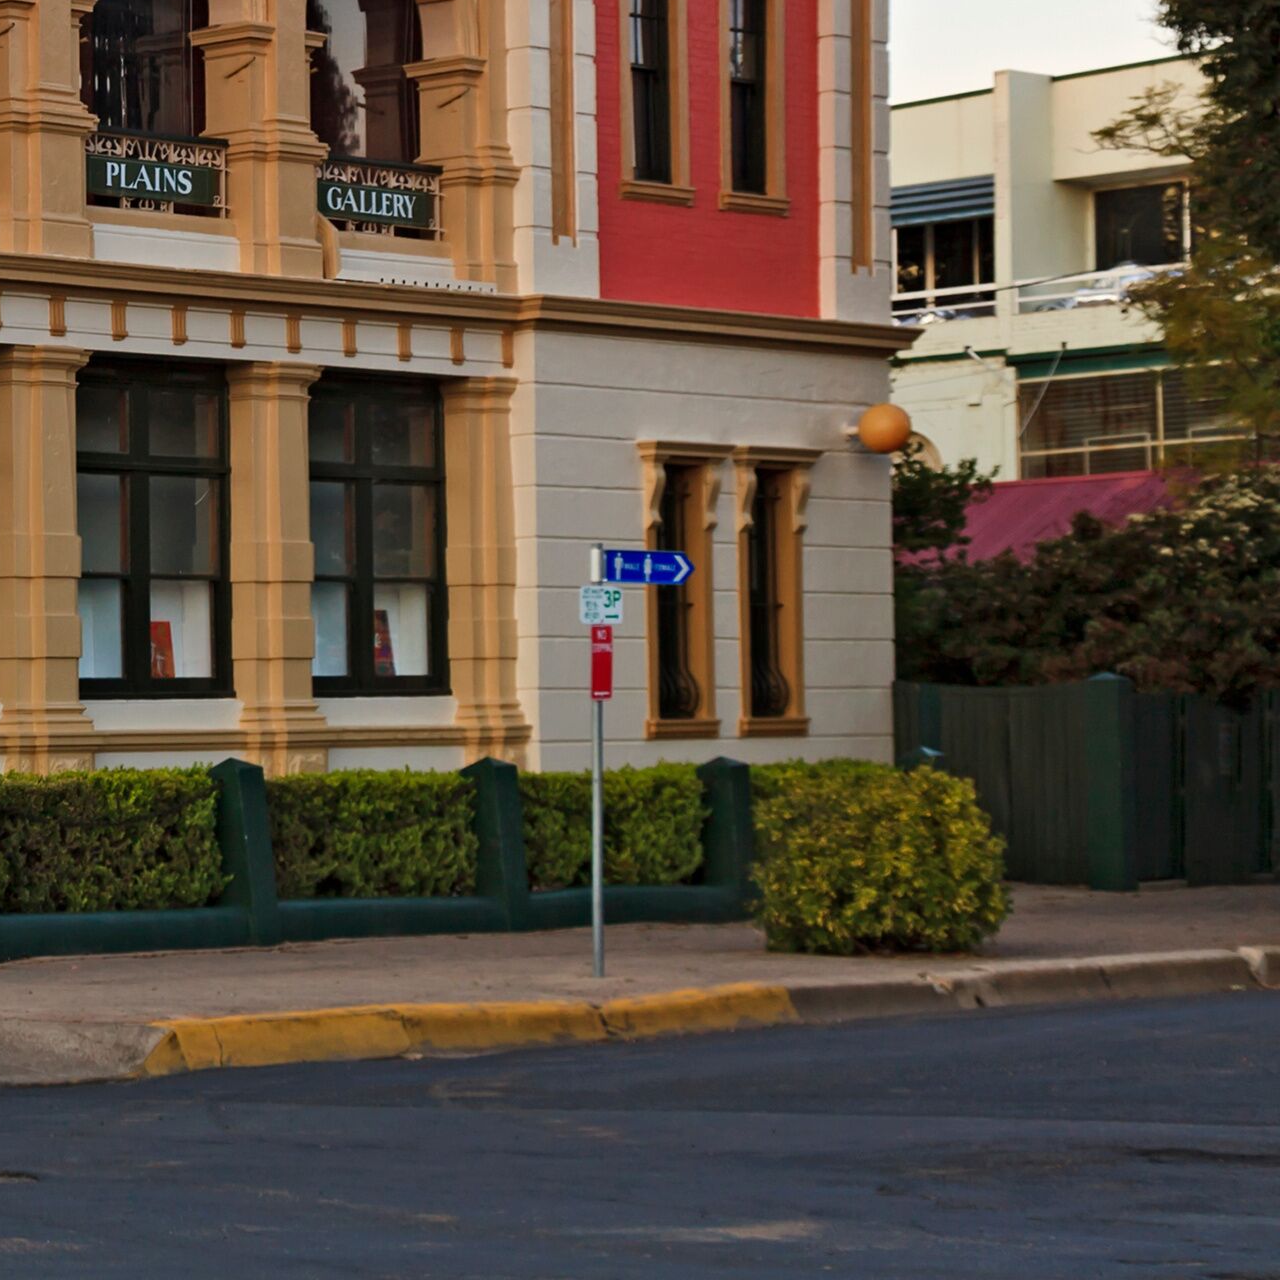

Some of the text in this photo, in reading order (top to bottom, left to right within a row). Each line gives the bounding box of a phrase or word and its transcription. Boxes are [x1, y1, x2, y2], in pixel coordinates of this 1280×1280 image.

[106, 161, 193, 195] PLAINS
[326, 186, 417, 219] GALLERY
[603, 590, 622, 608] 3P
